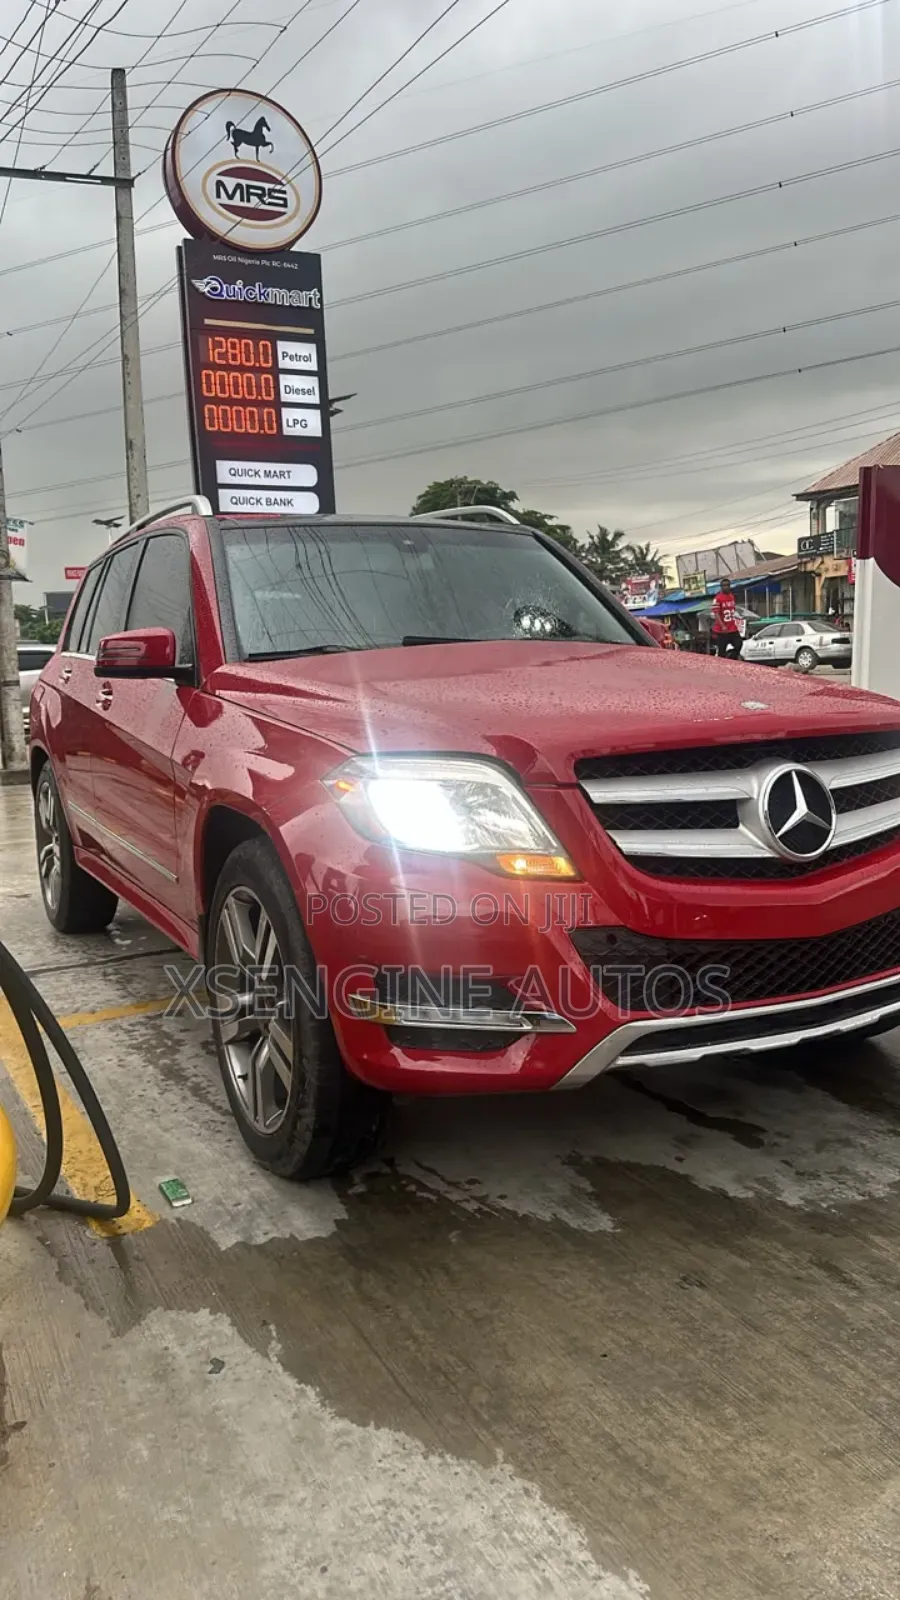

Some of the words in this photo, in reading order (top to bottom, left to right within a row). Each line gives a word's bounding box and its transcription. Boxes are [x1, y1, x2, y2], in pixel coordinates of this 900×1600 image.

[215, 179, 288, 208] MRS
[212, 254, 226, 262] MRS
[237, 256, 260, 266] Nigeria
[261, 259, 270, 267] Plc
[203, 275, 321, 309] Quickmart
[207, 336, 273, 368] 1280.0
[281, 351, 312, 363] Petrol
[201, 370, 275, 400] 0000.0
[284, 384, 316, 397] Diesel
[204, 404, 277, 435] 0000.0
[286, 418, 308, 429] LPG
[228, 467, 261, 479] QUICK
[263, 469, 292, 480] MART
[230, 495, 263, 507] QUICK
[265, 497, 294, 507] BANK
